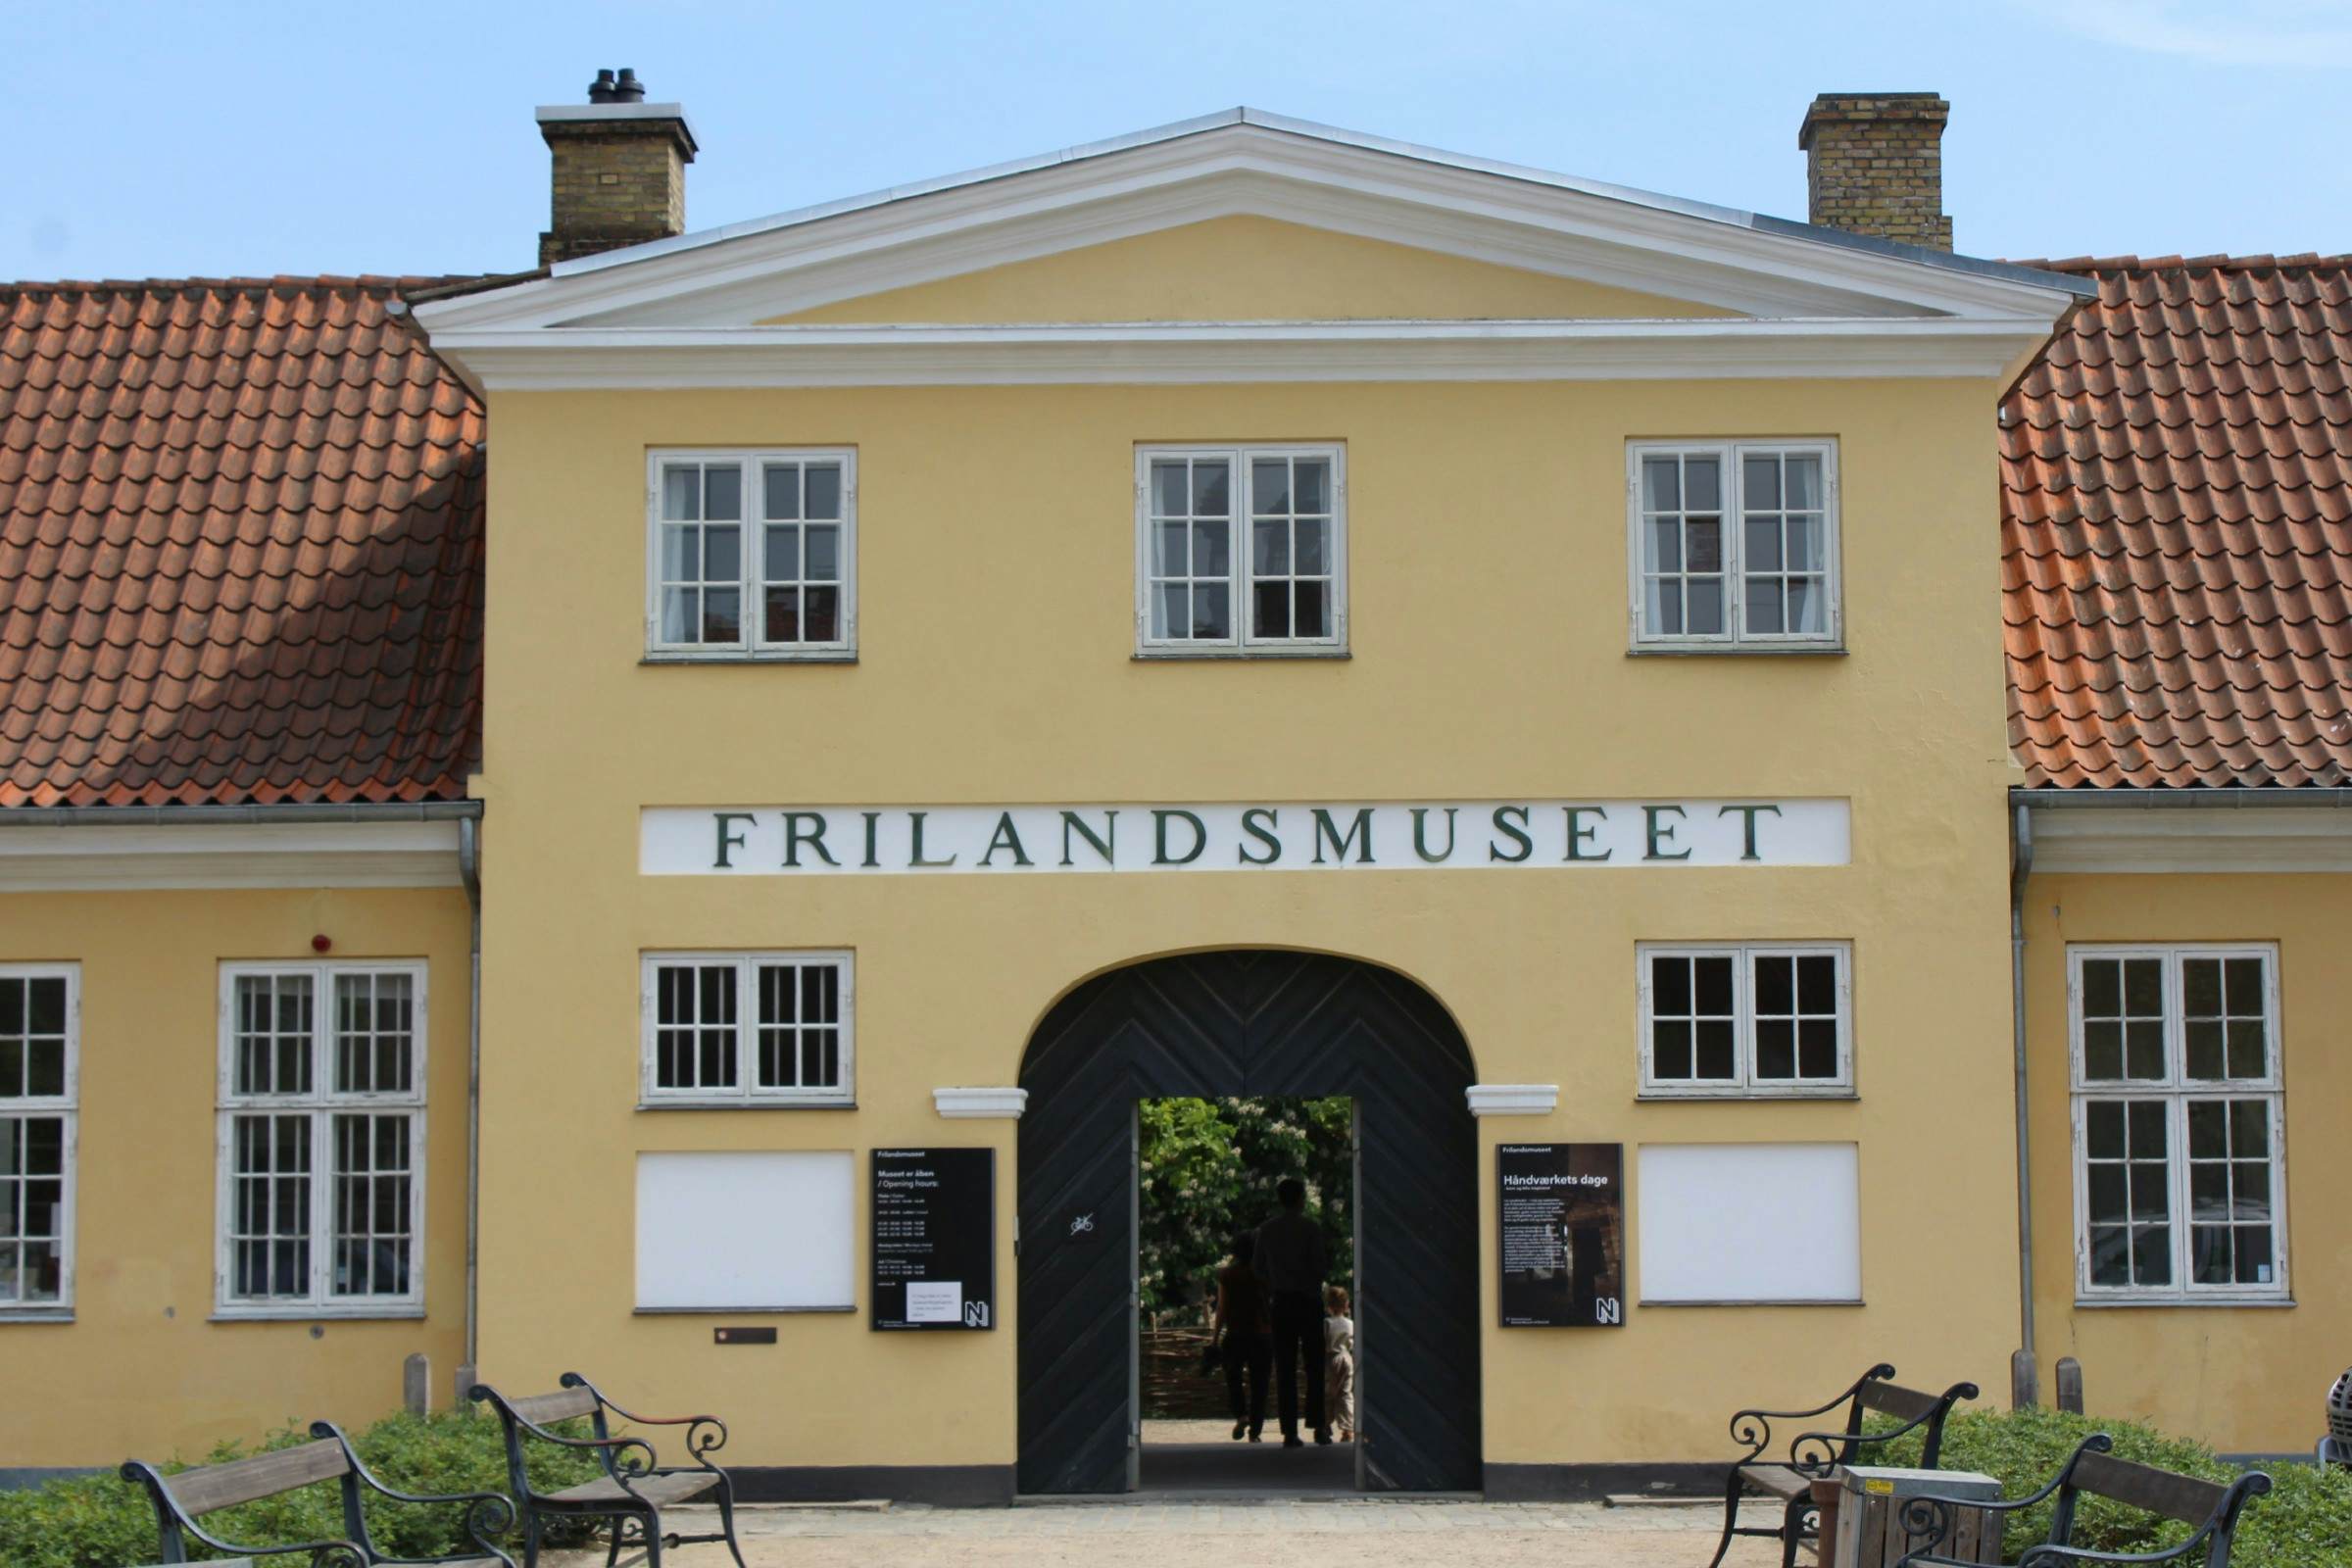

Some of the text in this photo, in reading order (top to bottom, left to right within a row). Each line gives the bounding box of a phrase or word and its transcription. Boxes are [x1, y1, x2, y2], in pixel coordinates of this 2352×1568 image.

[712, 804, 1784, 869] FRILANDSMUSEET
[882, 1180, 913, 1190] Opening
[1503, 1174, 1608, 1188] Håndværkets dage
